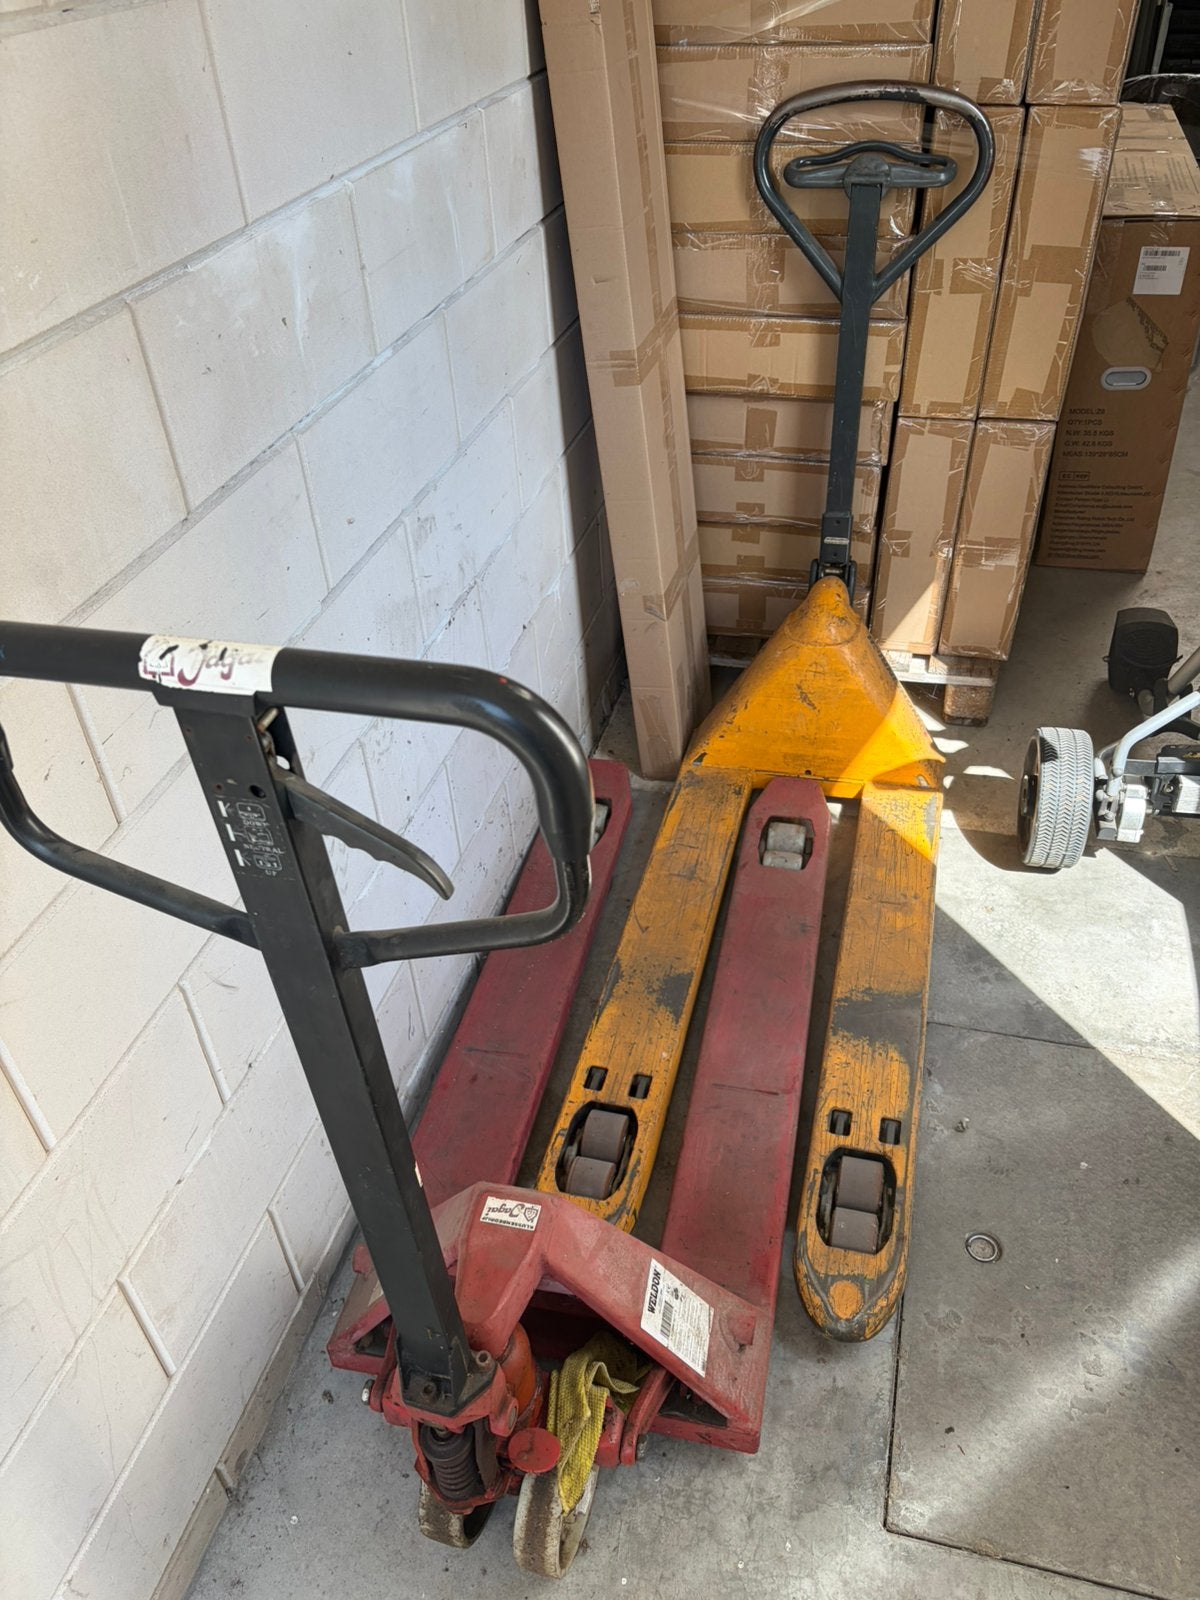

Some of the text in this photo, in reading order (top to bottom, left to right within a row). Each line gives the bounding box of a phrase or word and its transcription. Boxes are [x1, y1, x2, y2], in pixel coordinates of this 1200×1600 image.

[485, 1203, 526, 1218] Jagai
[482, 1216, 534, 1230] KLUSSENBEDRIJF
[647, 1269, 661, 1314] WELDON
